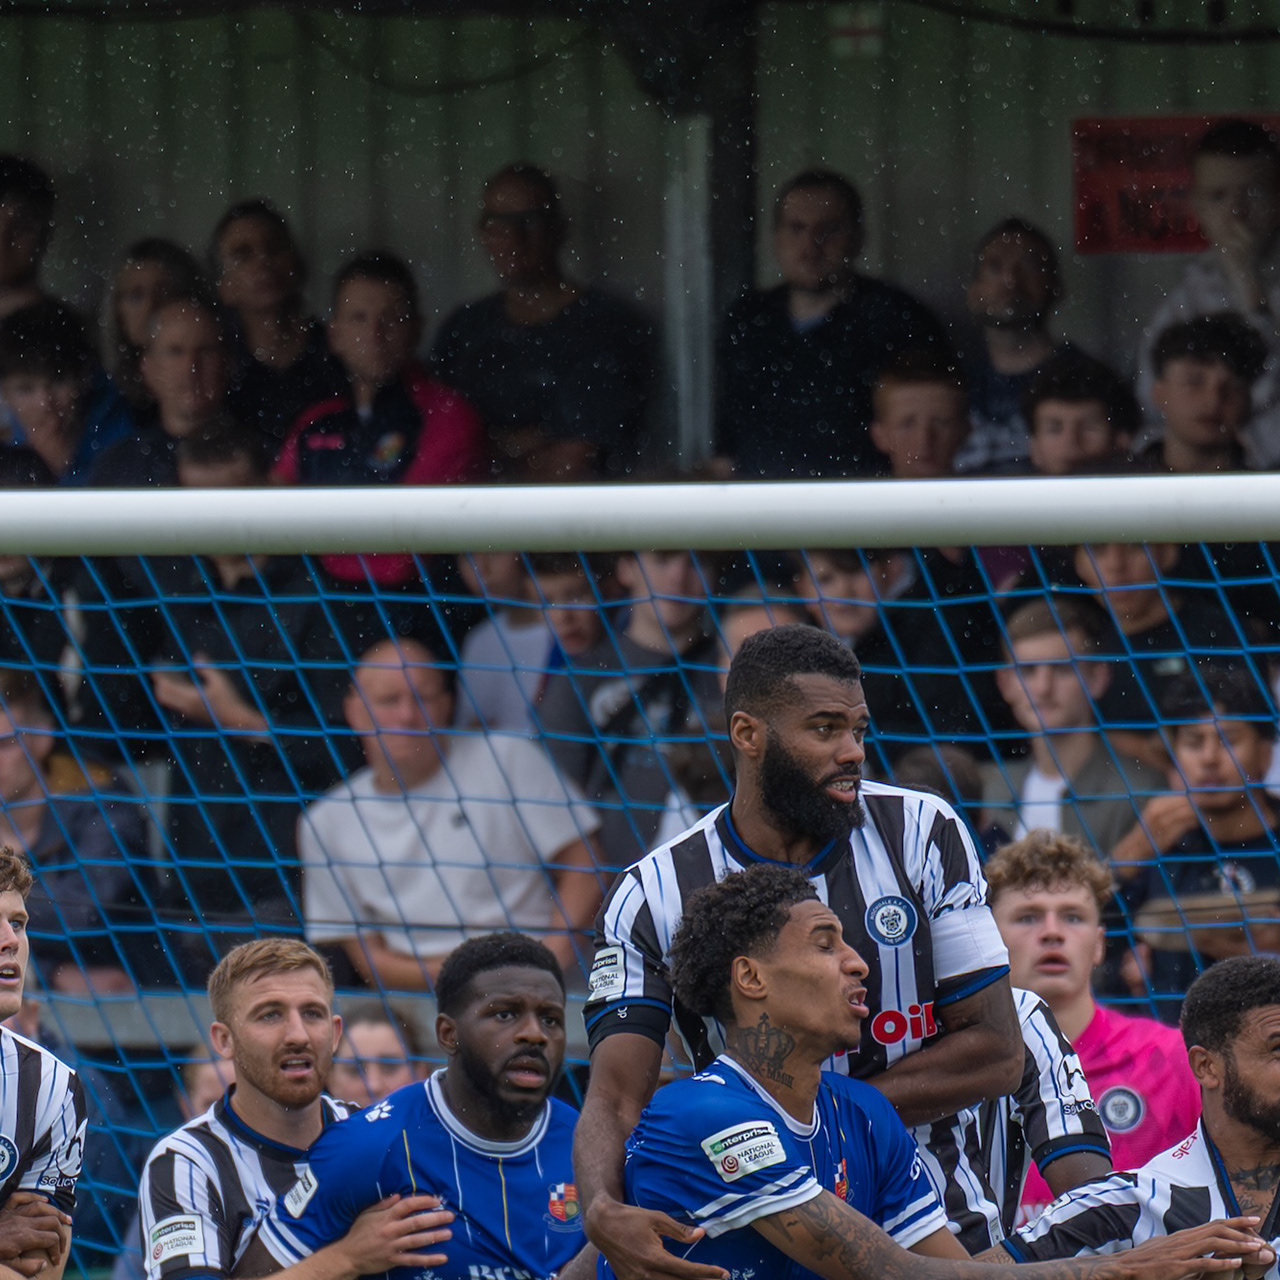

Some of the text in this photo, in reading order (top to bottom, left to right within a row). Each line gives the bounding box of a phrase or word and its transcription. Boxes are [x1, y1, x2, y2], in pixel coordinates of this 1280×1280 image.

[736, 1140, 777, 1159] NATIONAL
[743, 1147, 775, 1164] LEAGUE
[163, 1235, 197, 1247] NATIONAL
